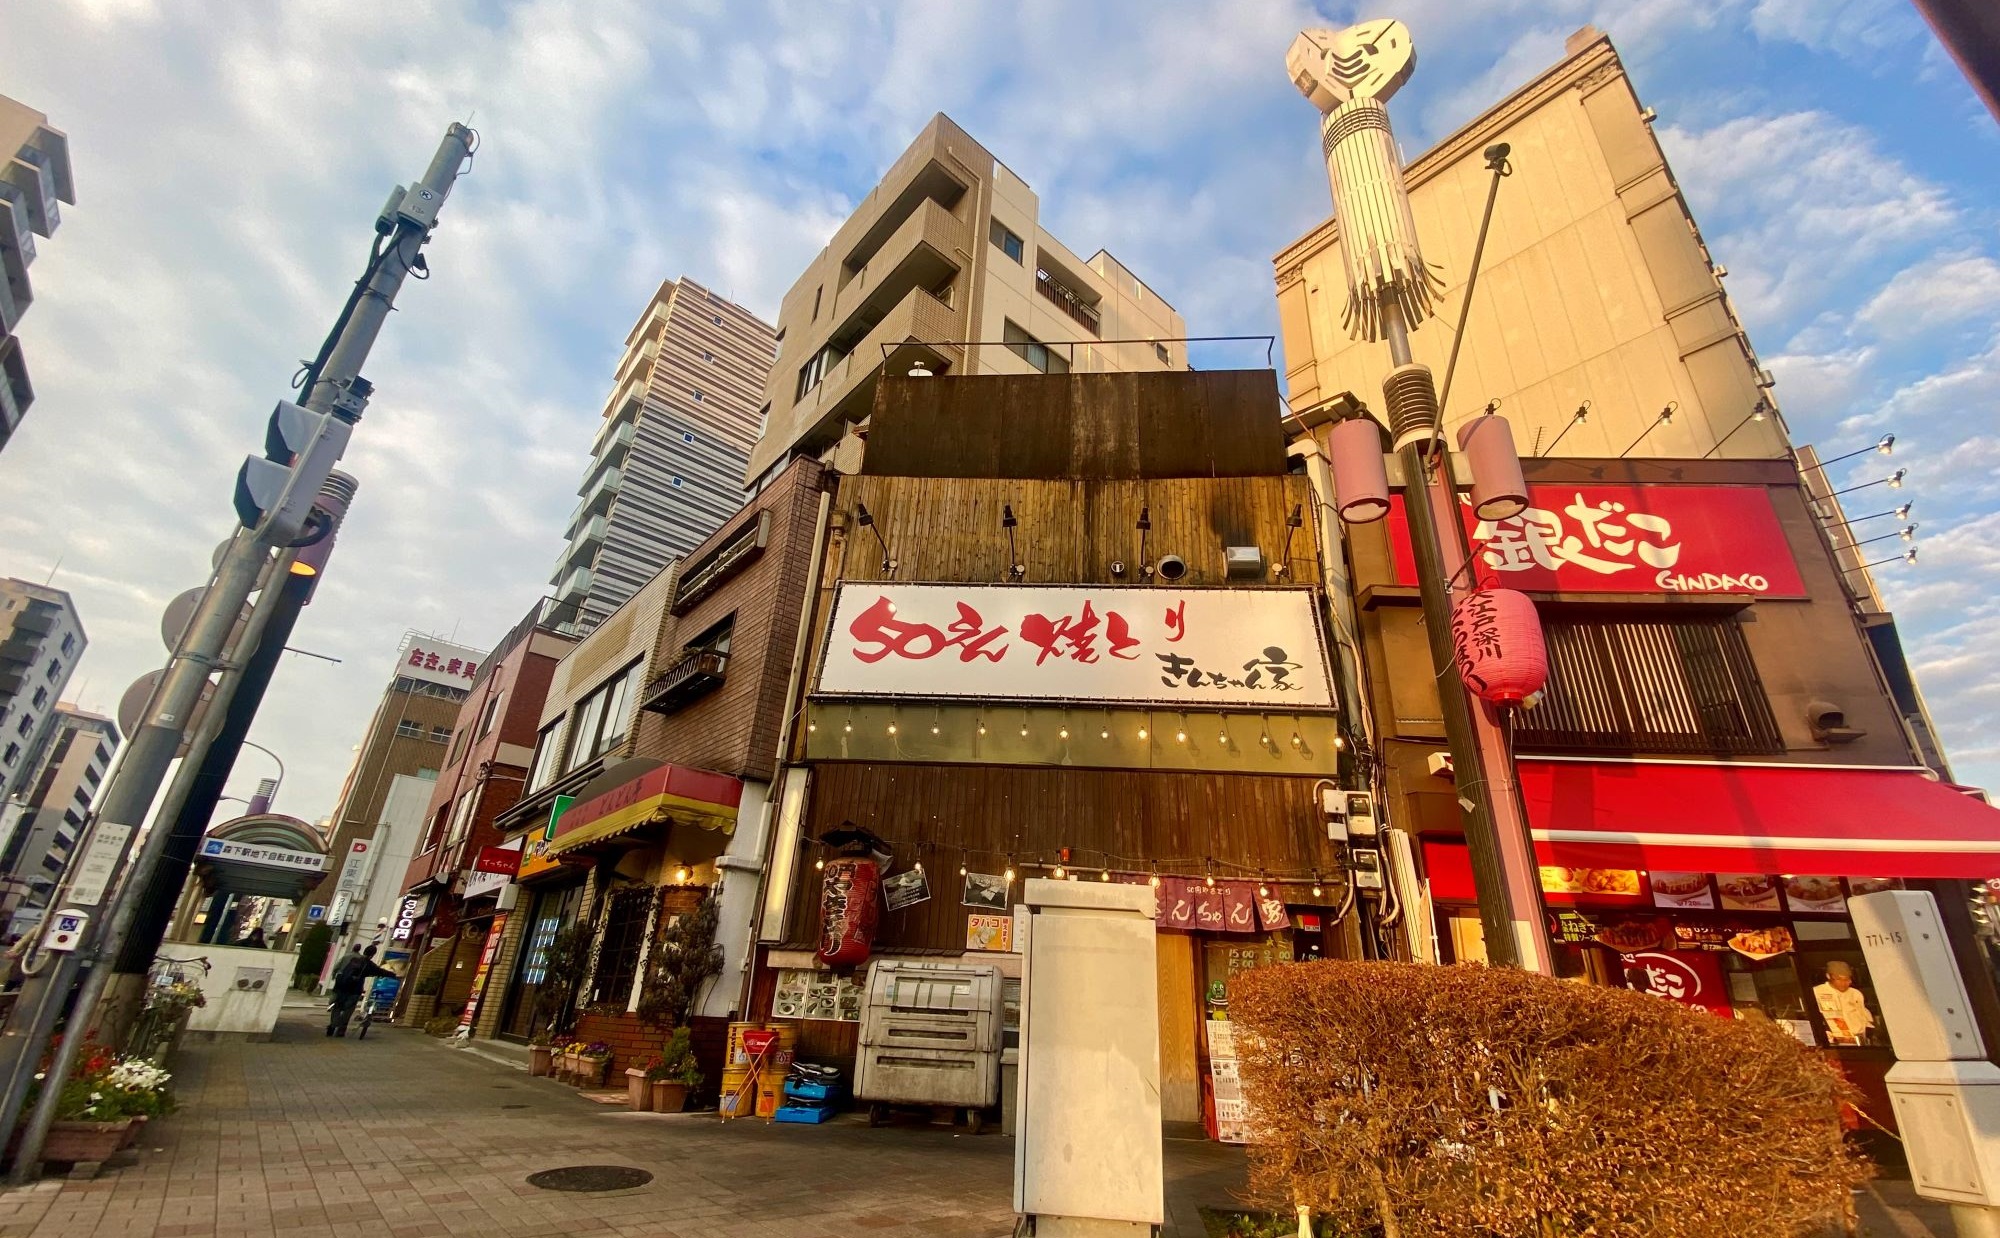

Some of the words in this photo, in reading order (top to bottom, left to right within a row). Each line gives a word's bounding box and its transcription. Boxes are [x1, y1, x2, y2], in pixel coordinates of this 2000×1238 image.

[1473, 492, 1680, 574] 銀だこ
[1656, 569, 1769, 592] GINDACO
[1155, 645, 1304, 692] きんちゃん家
[971, 918, 1000, 928] タバコ
[1865, 932, 1902, 947] 771-15
